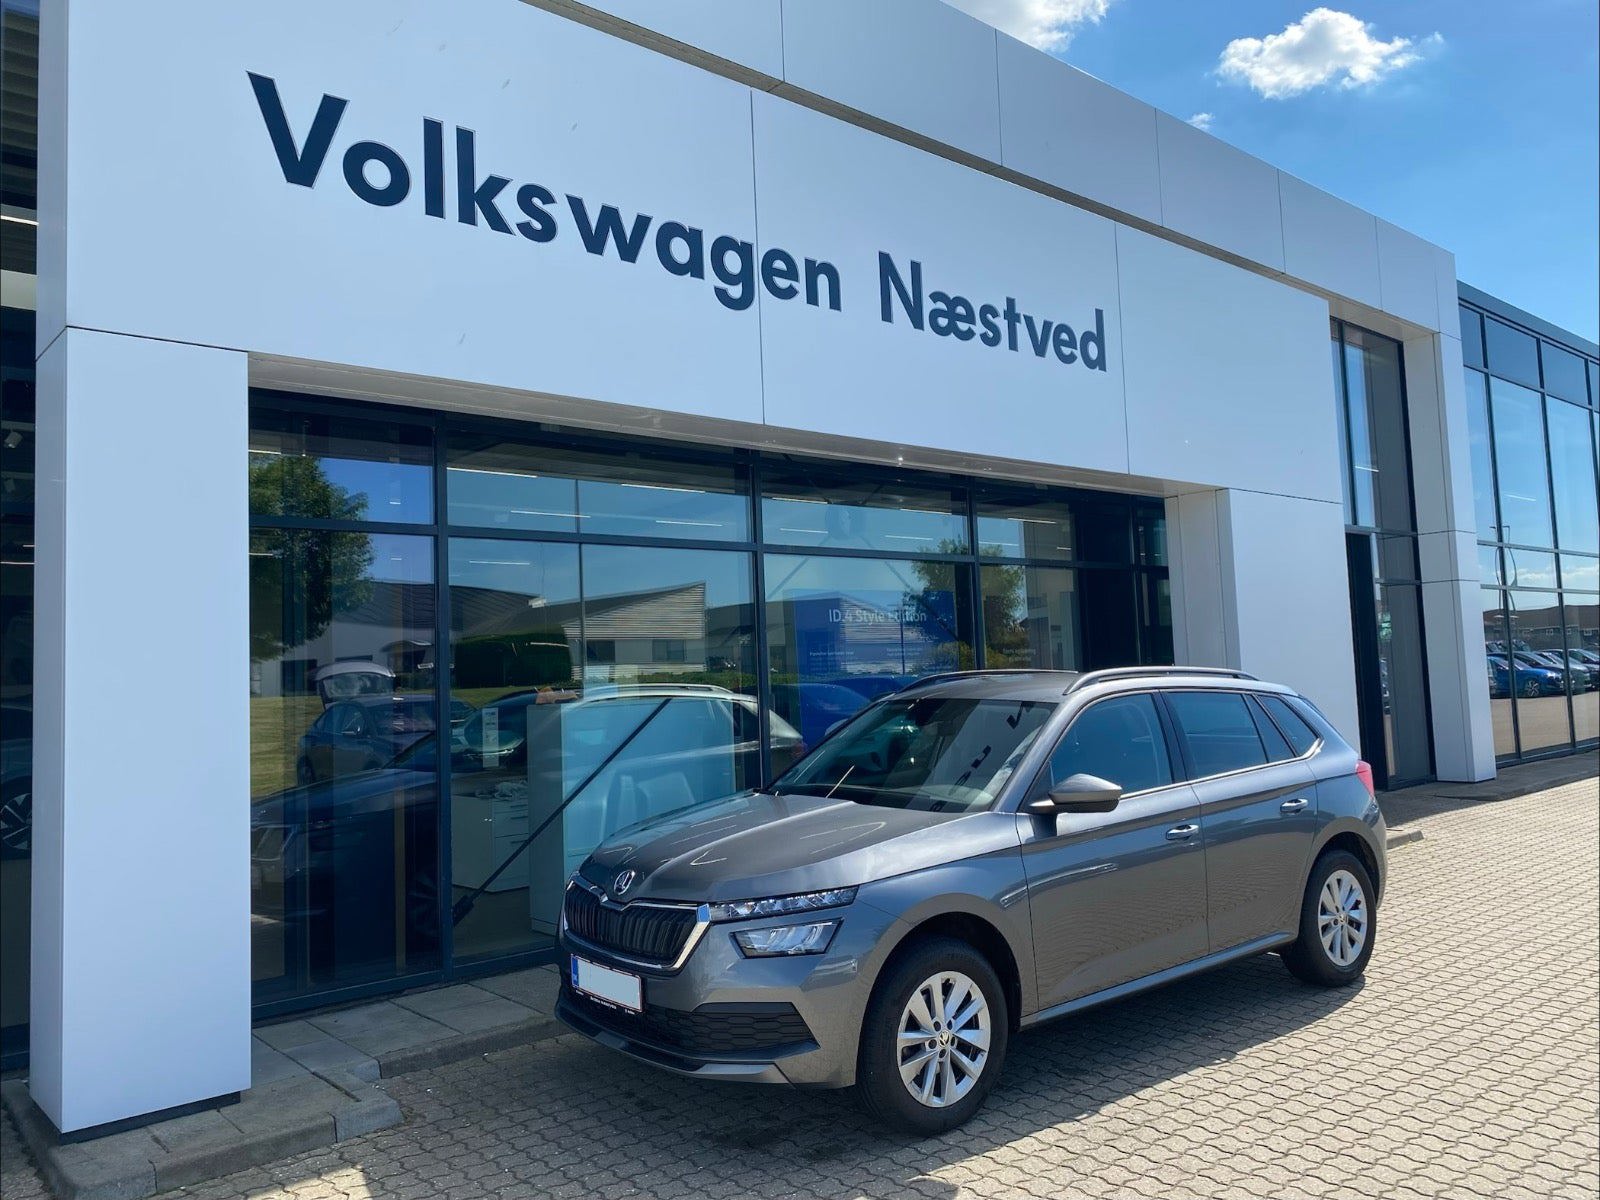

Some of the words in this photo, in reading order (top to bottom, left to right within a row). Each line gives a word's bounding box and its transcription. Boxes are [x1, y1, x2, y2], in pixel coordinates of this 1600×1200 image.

[245, 70, 842, 311] Volkswagen
[878, 250, 1107, 373] Næstved
[828, 608, 854, 623] ID.4
[855, 608, 885, 625] Style
